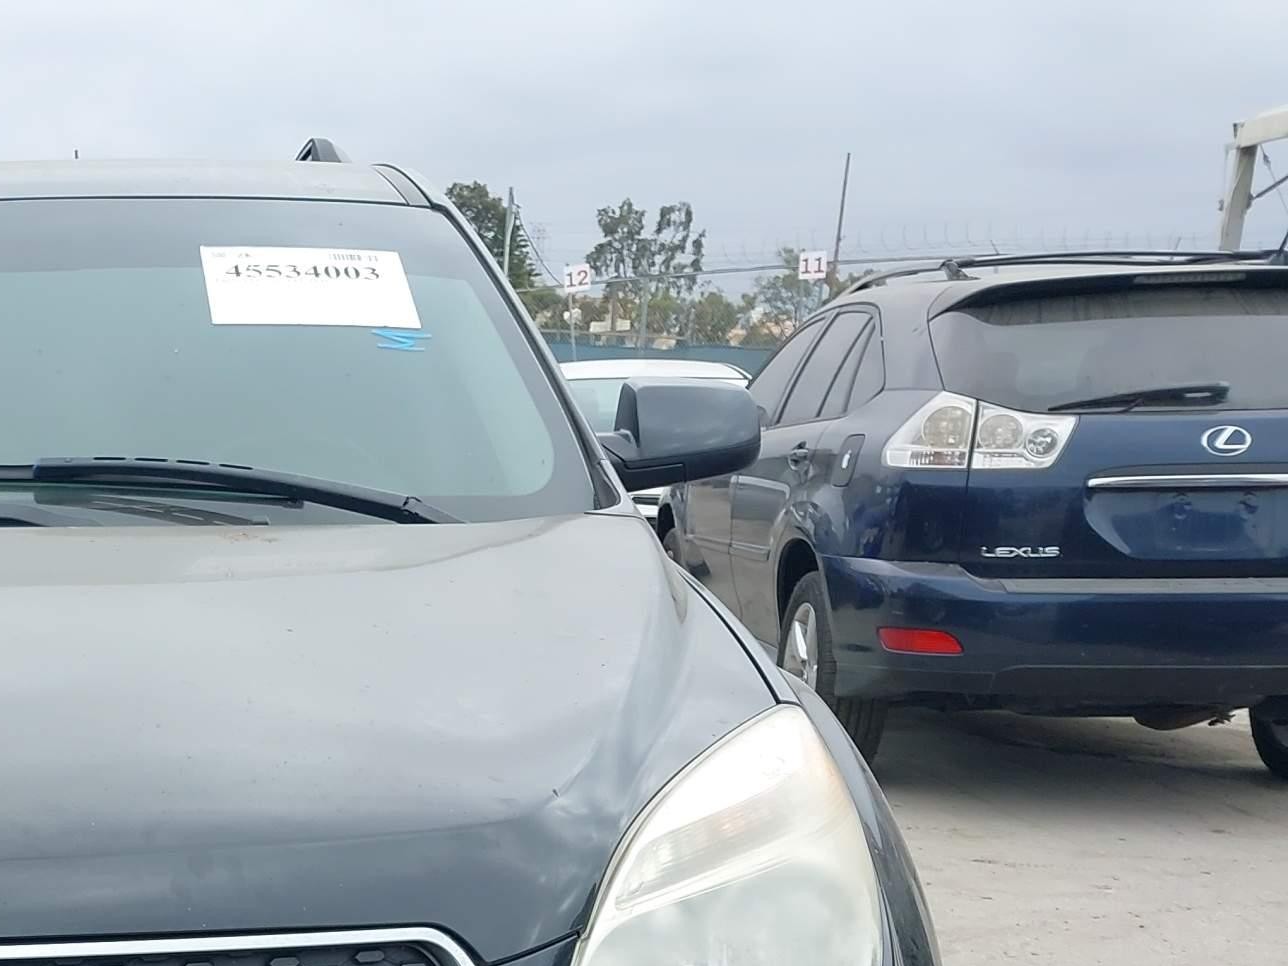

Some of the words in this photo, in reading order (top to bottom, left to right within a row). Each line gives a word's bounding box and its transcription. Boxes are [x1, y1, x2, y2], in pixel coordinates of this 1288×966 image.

[225, 264, 380, 280] 45534003
[801, 256, 825, 274] 11
[566, 270, 589, 288] 12
[980, 546, 1061, 558] LEXUS
